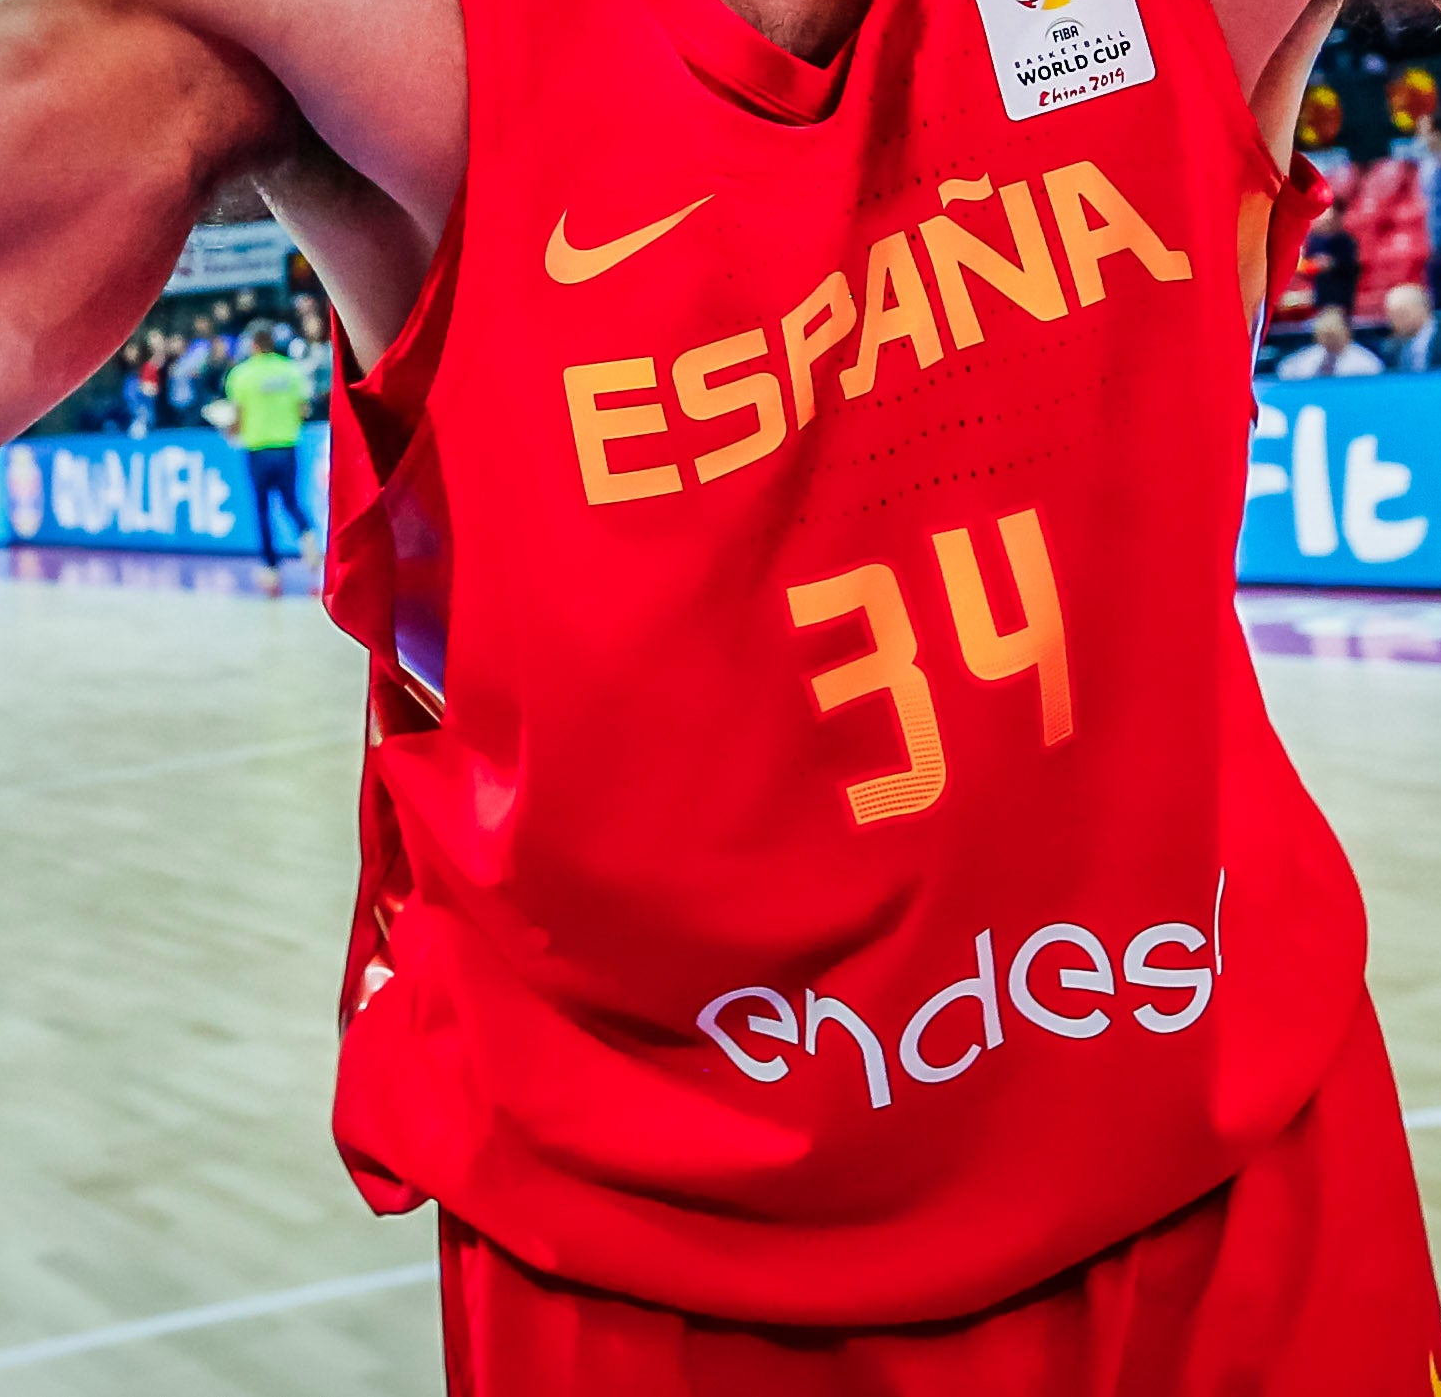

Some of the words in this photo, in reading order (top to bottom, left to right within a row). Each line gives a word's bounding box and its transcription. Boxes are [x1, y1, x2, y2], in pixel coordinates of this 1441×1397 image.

[1014, 30, 1125, 69] BASKETBALL
[1052, 25, 1080, 43] FIBA
[1016, 54, 1089, 86] WORLD
[1093, 40, 1131, 64] CUP
[1038, 85, 1087, 107] China
[1088, 67, 1125, 91] 2019
[562, 159, 1193, 506] ESPAÑA
[786, 507, 1074, 826] 34
[696, 867, 1226, 1109] endes
